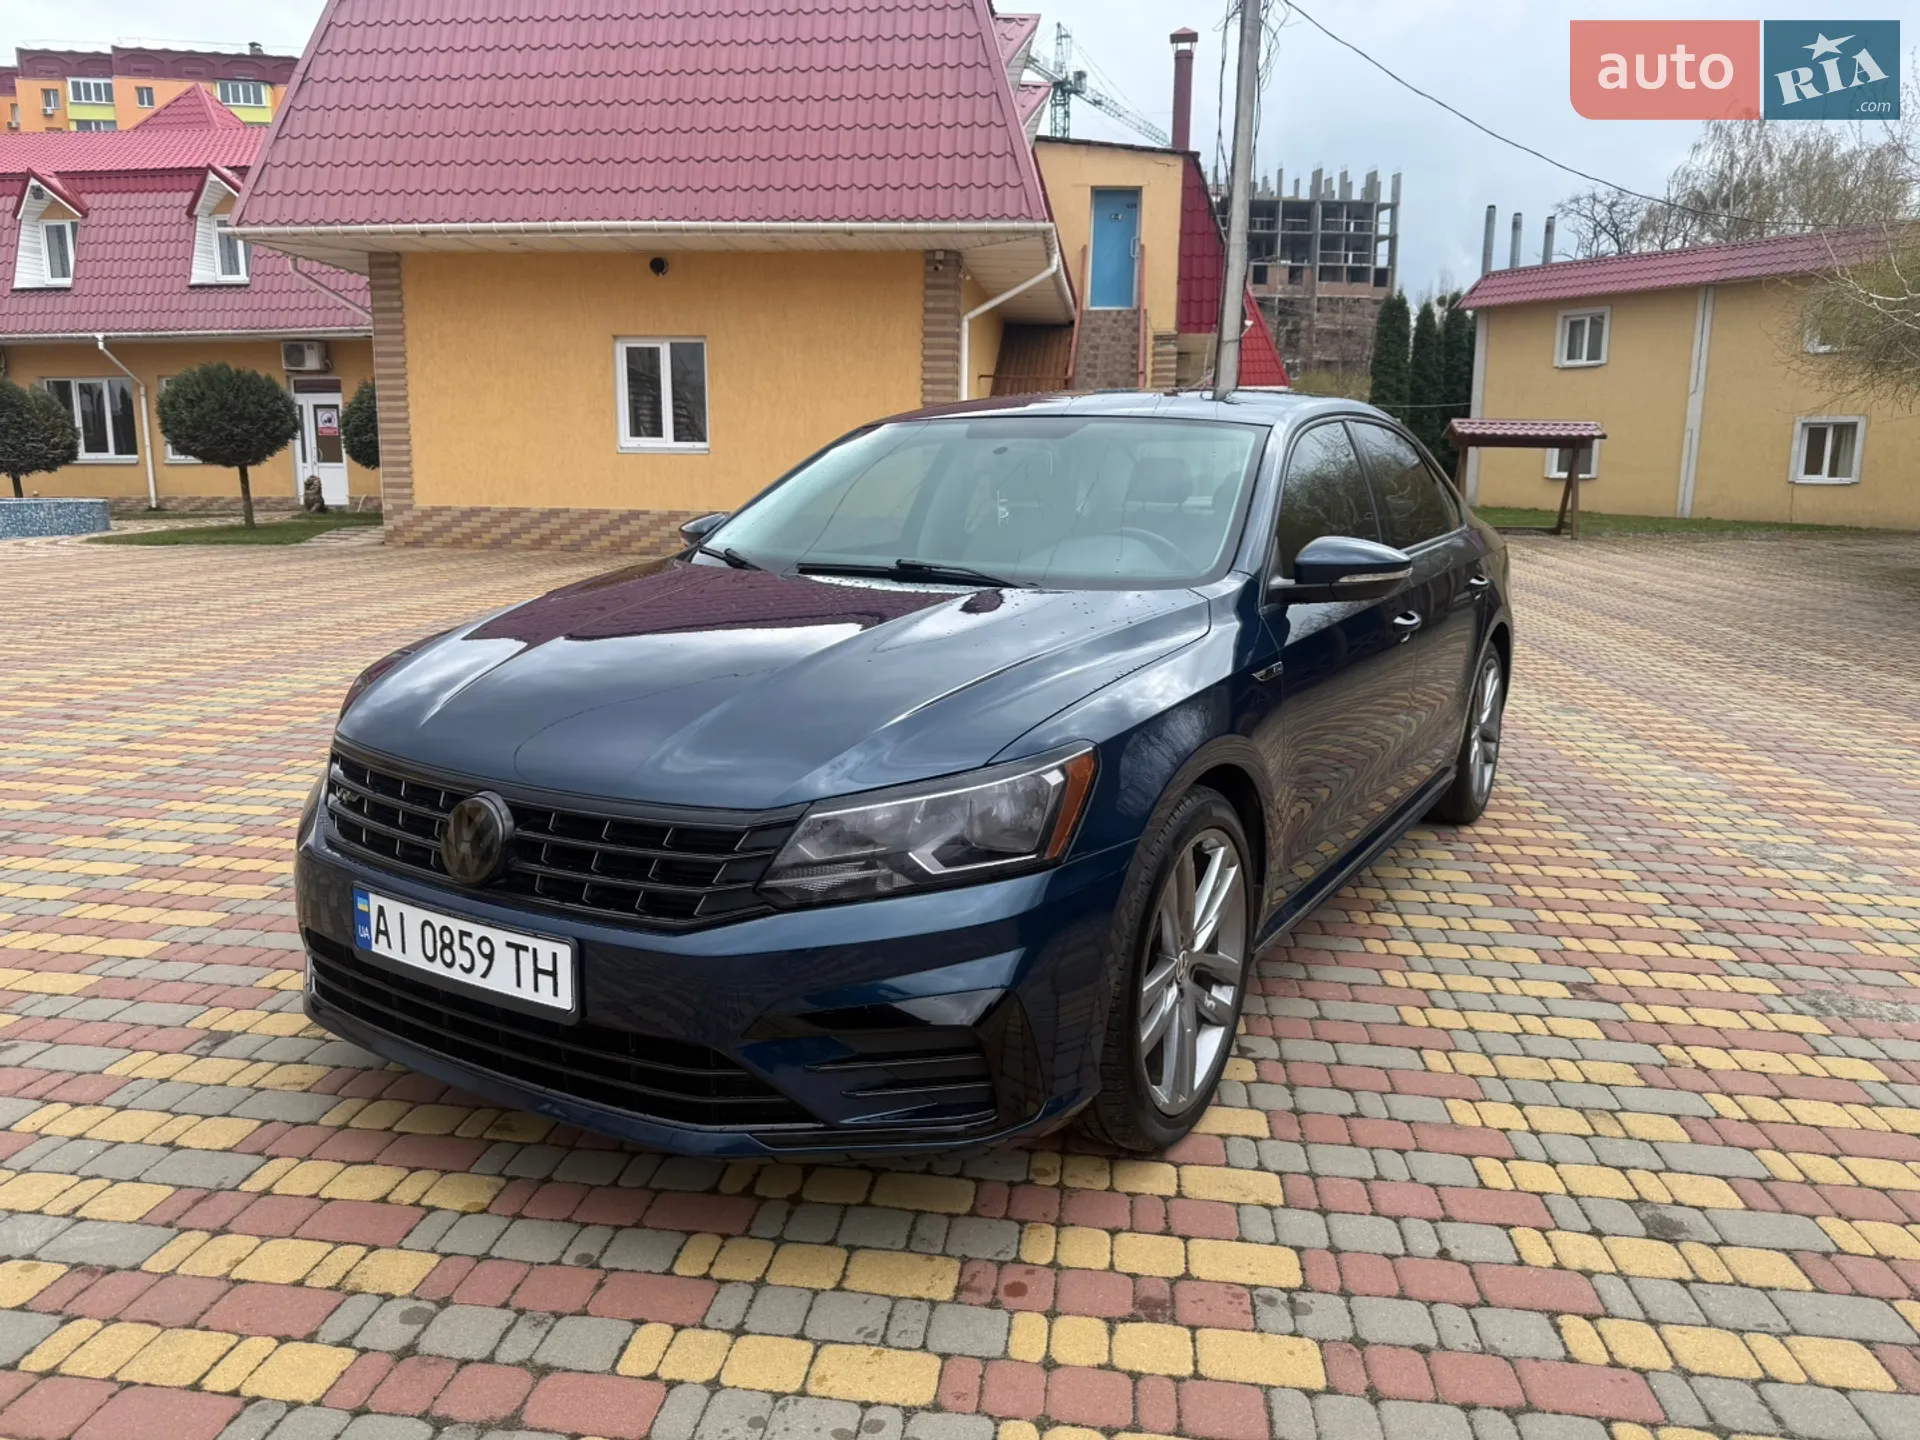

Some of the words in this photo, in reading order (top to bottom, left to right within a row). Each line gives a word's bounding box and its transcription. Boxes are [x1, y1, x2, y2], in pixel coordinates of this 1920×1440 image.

[358, 924, 371, 940] UA
[374, 904, 406, 955] AI
[421, 919, 495, 979] 0859
[505, 940, 559, 998] TH
